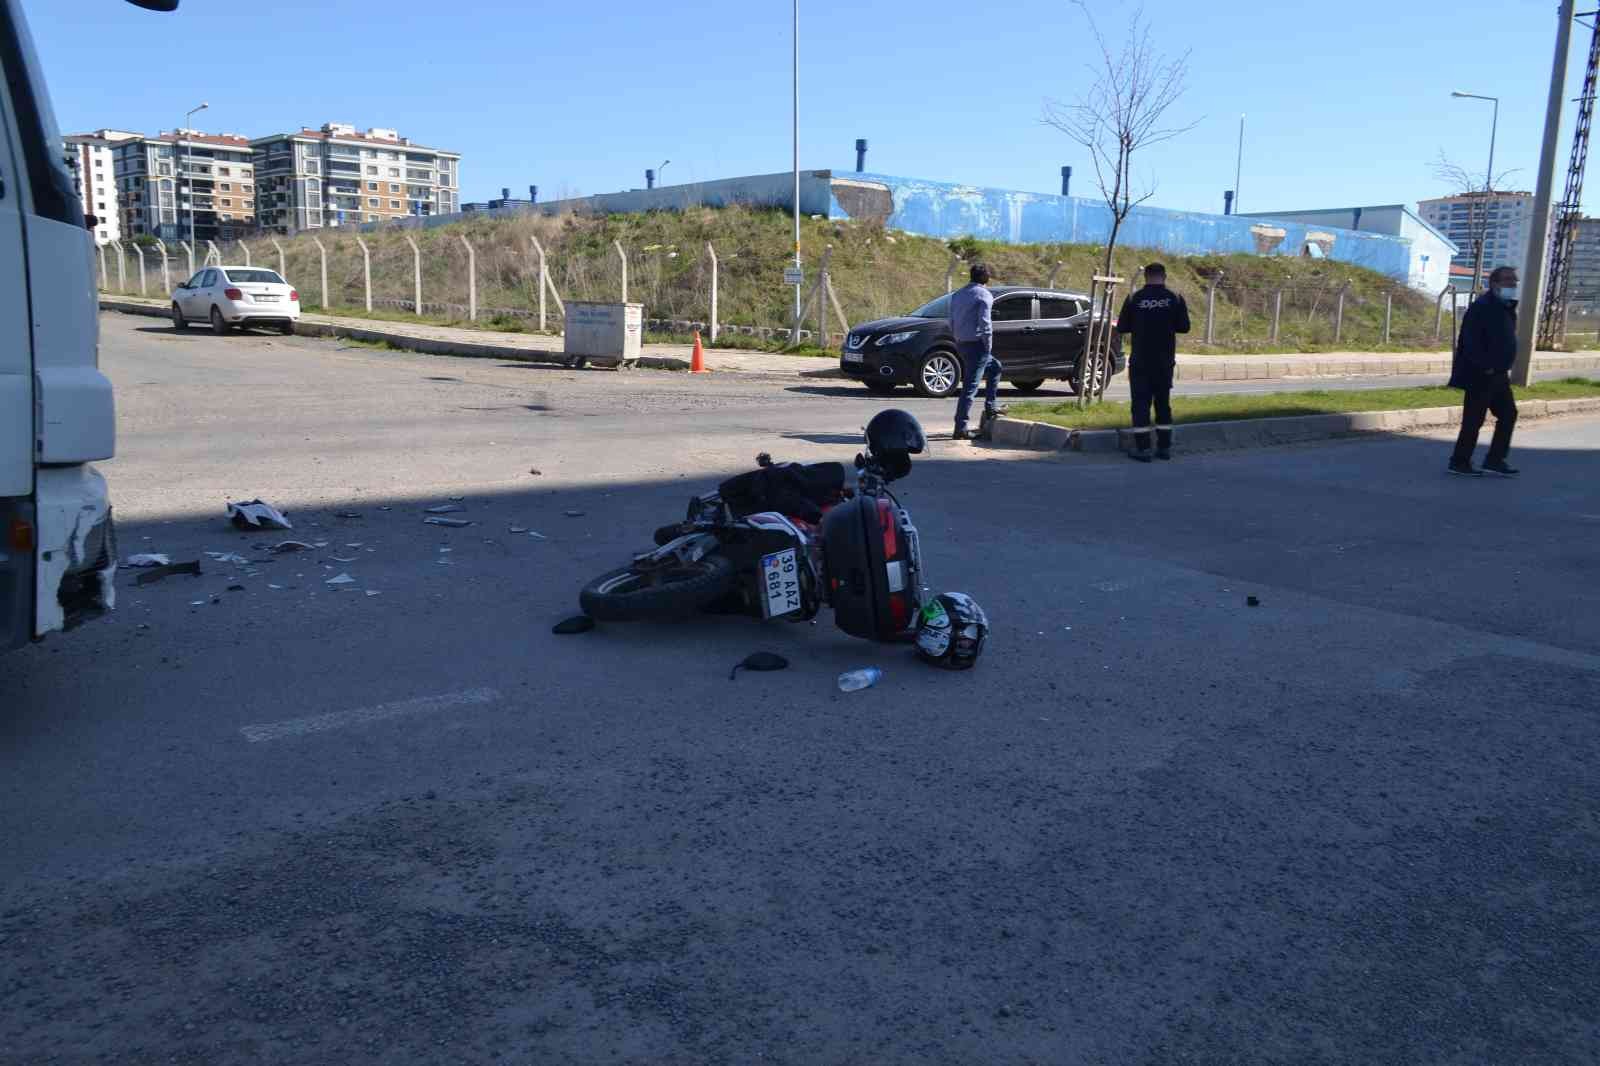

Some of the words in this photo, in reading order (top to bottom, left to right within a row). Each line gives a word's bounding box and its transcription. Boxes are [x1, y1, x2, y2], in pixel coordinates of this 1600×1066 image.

[782, 555, 794, 573] 39
[768, 571, 782, 599] 681
[784, 581, 799, 608] AAZ
